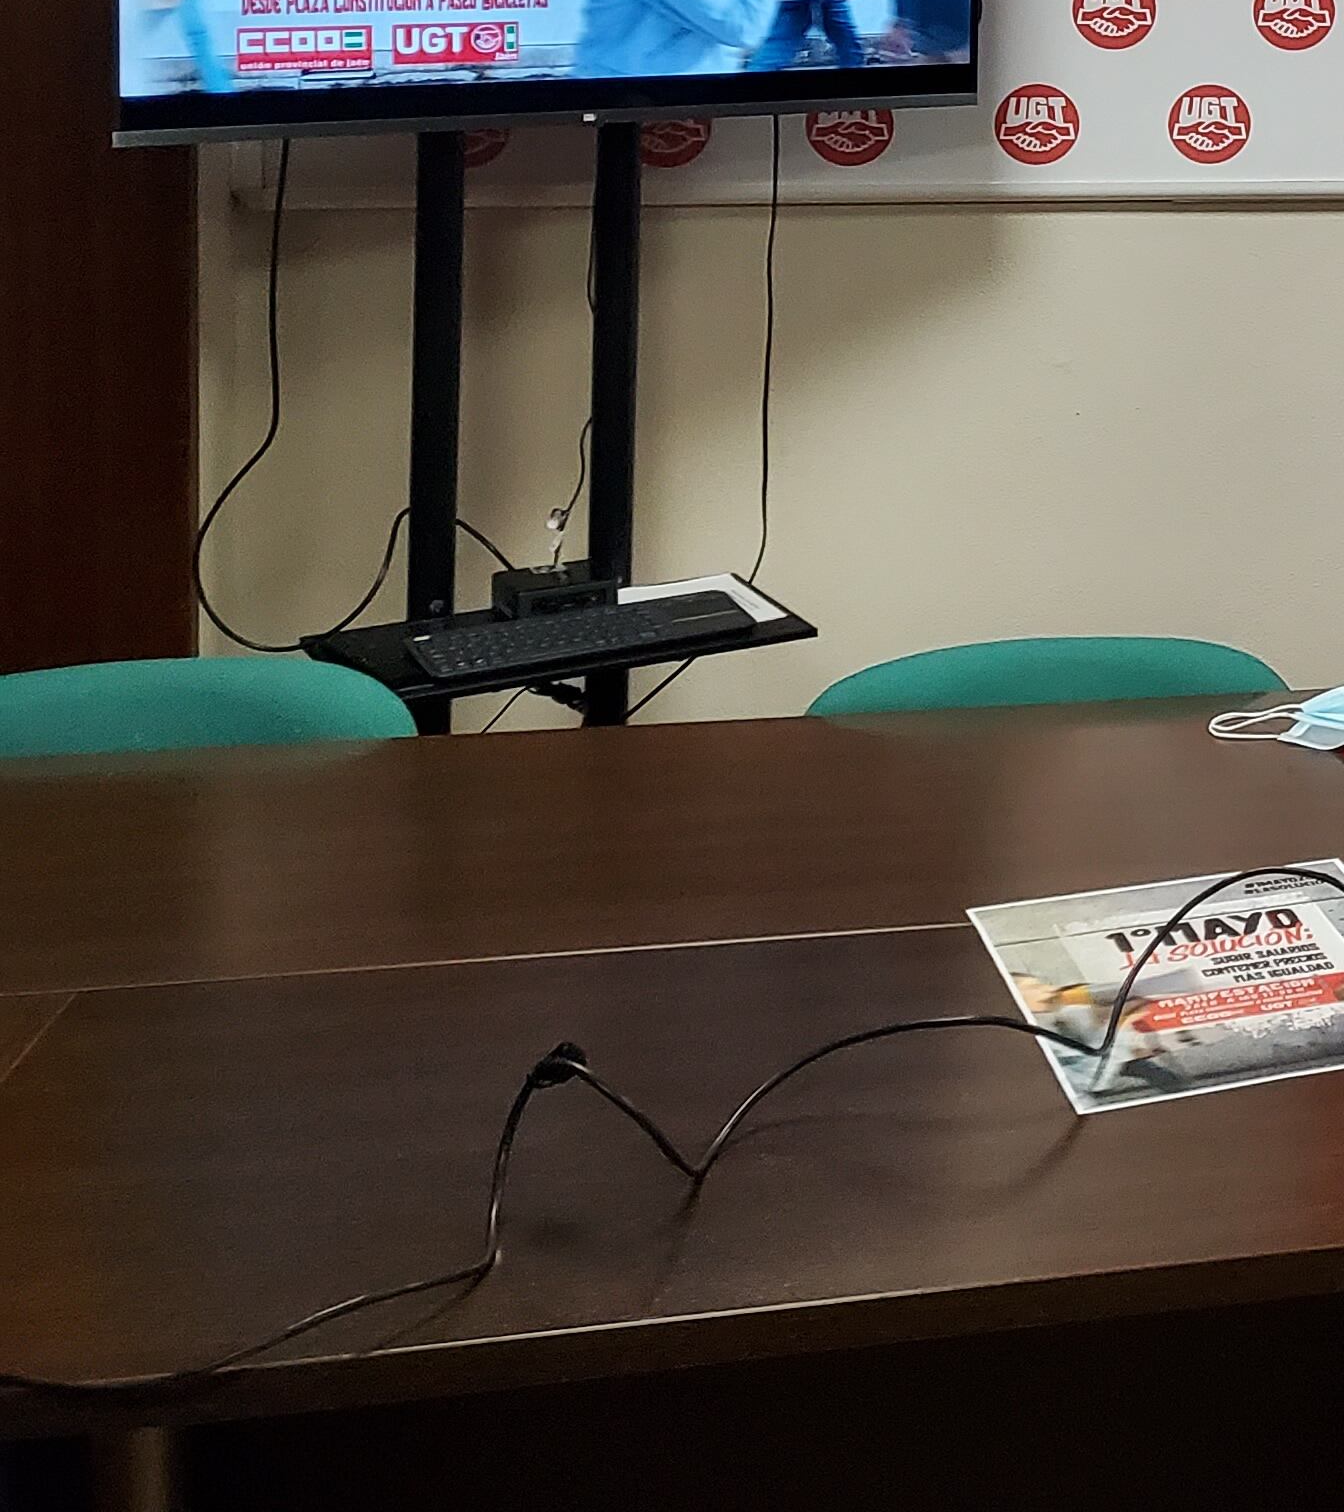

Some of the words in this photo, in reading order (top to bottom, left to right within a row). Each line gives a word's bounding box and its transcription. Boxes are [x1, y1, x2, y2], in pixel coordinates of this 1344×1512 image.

[240, 30, 342, 54] CCOO
[396, 26, 469, 55] UGT
[1008, 94, 1068, 124] UGT
[1181, 94, 1240, 124] UGT
